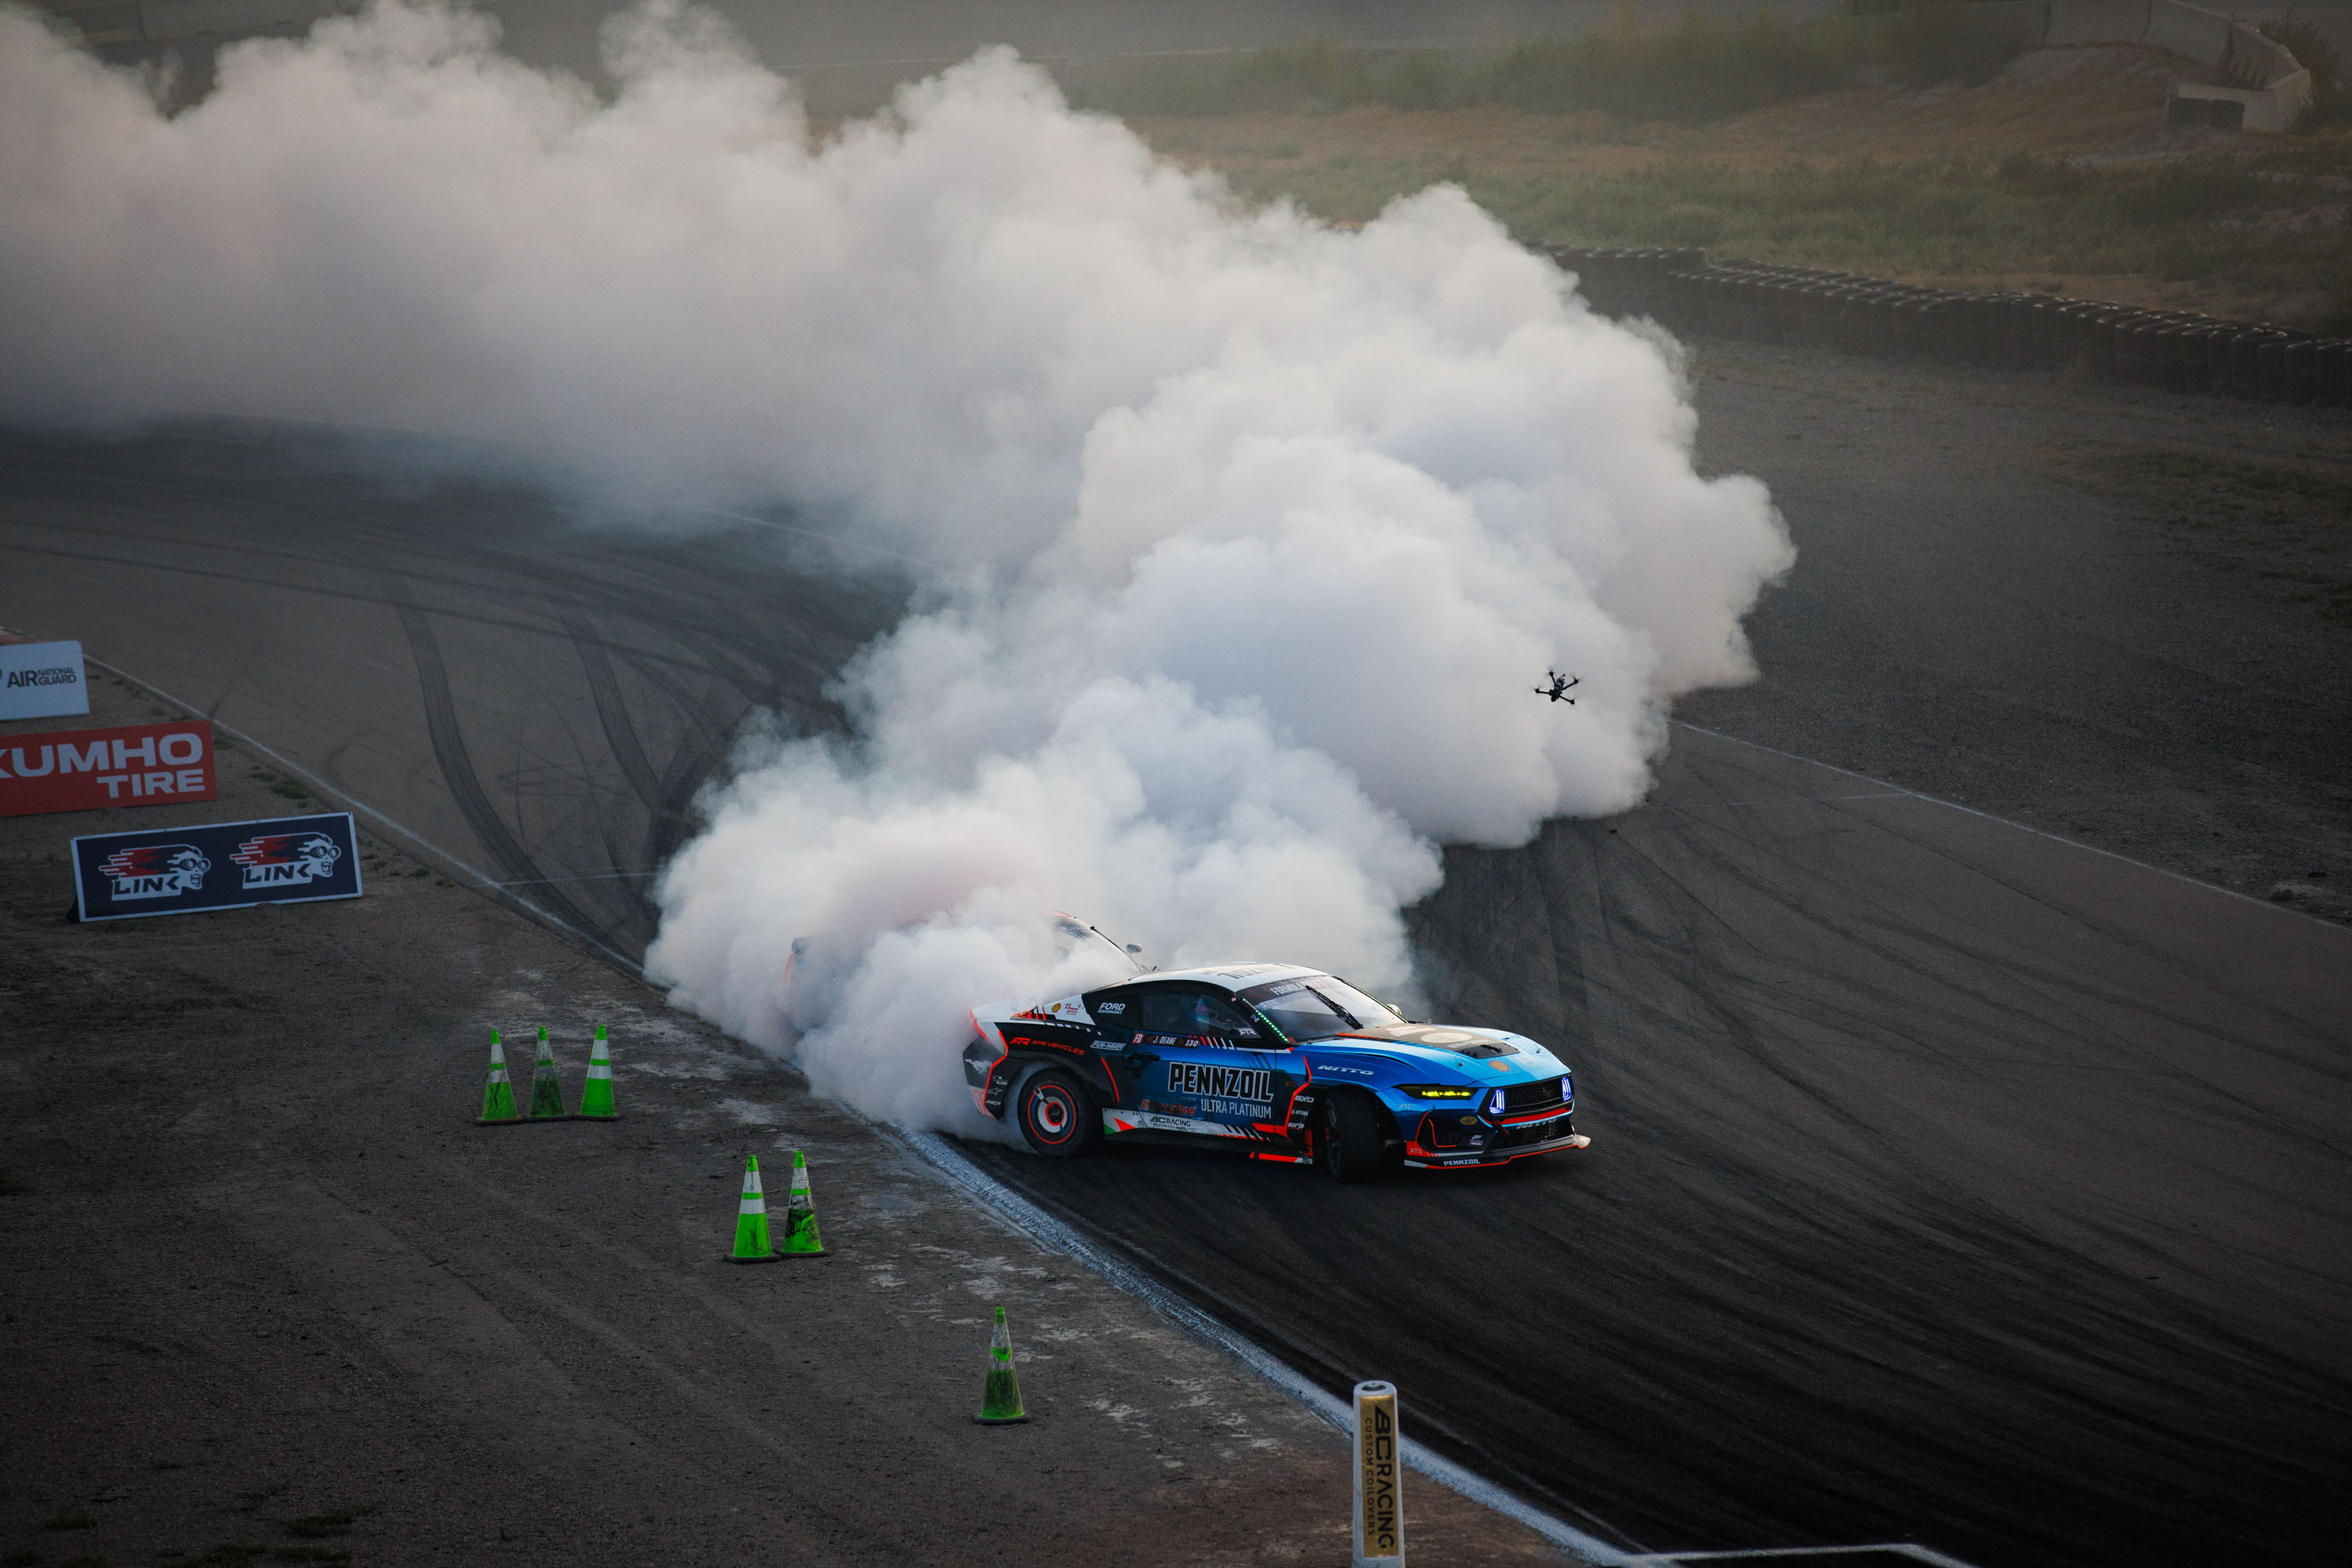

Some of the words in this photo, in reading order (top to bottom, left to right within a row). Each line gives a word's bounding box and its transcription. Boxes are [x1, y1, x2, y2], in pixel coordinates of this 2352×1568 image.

[8, 670, 38, 688] AIR
[38, 667, 75, 676] NATIONAL
[38, 674, 76, 686] GUARD
[97, 769, 205, 798] TIRE
[245, 863, 311, 883] LINK
[113, 876, 180, 895] LINK
[1099, 1002, 1126, 1011] FORD
[1133, 1034, 1142, 1044] FD
[1159, 1036, 1177, 1045] DEANE
[1047, 1042, 1085, 1055] VEHICLES
[1318, 1065, 1374, 1076] NITTO
[1168, 1062, 1274, 1102] PENNZOIL
[1200, 1098, 1228, 1114] ULTRA
[1229, 1102, 1272, 1120] PLATINUM
[1515, 1117, 1557, 1130] NITTO
[1443, 1158, 1481, 1167] PENNZOIL
[1364, 1417, 1373, 1468] CUSTOM
[1367, 1471, 1375, 1536] COILOVERS
